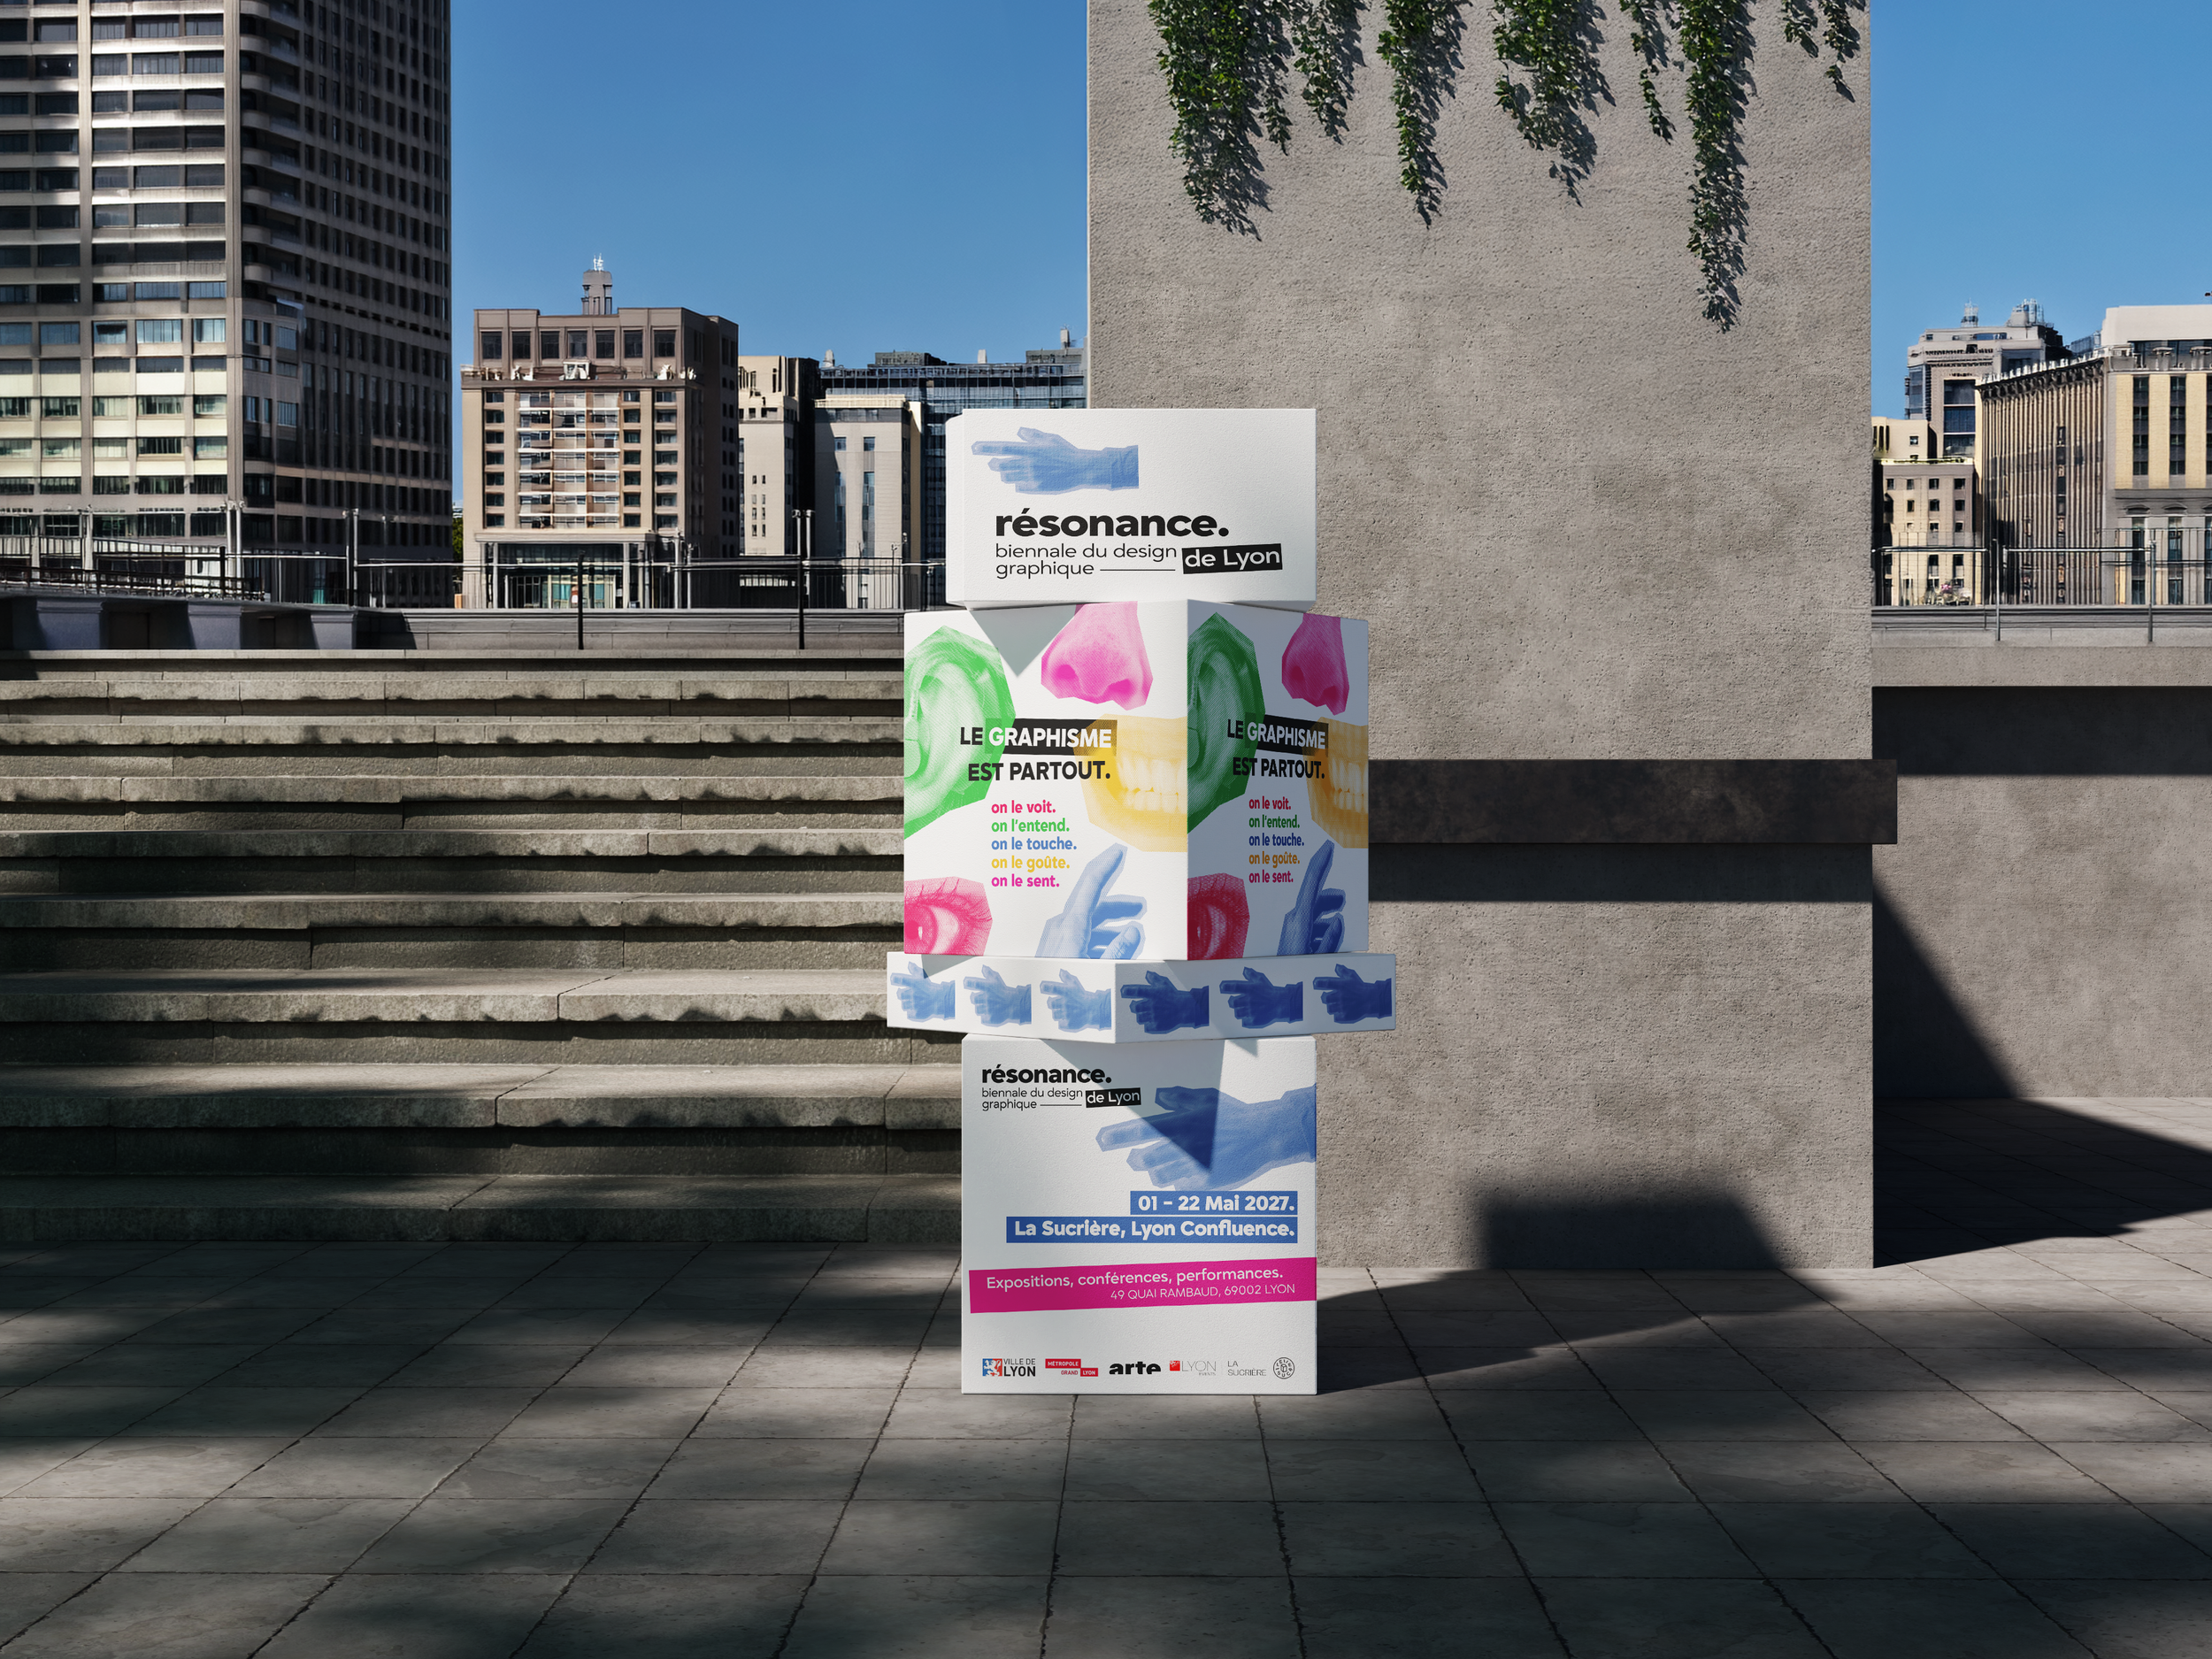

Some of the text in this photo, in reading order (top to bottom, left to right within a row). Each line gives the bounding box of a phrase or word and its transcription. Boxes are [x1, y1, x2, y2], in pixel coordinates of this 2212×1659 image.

[995, 508, 1229, 537] résonance.
[995, 543, 1279, 570] biennale du design de Lyon
[995, 560, 1094, 579] graphique
[961, 727, 1111, 748] LE GRAPHISME
[1227, 719, 1325, 749] LE GRAPHISME
[969, 761, 1110, 781] EST PARTOUT.
[1233, 757, 1325, 779] EST PARTOUT.
[992, 800, 1056, 813] on le voit.
[1249, 796, 1291, 810] on le voit.
[992, 822, 1007, 832] on
[1249, 818, 1260, 827] on
[992, 836, 1077, 849] on le touche.
[1249, 833, 1304, 846] on le touche.
[992, 856, 1070, 872] on le goûte.
[1249, 851, 1300, 868] on le goûte.
[992, 873, 1060, 887] on le sent.
[1249, 870, 1294, 883] on le sent.
[982, 1064, 1111, 1083] résonance.
[982, 1087, 1140, 1105] biennale du design de Lyon
[982, 1099, 1037, 1111] graphique
[1139, 1195, 1157, 1210] 01
[1179, 1196, 1201, 1210] 22
[1205, 1195, 1240, 1210] Mai
[1245, 1196, 1294, 1211] 2027.
[1015, 1220, 1294, 1240] La Sucrière, Lyon Confluence.
[987, 1267, 1283, 1292] Expositions, conférences, performances.
[1110, 1284, 1295, 1300] 49 QUAI RAMBAUD, 69002 LYON
[1003, 1366, 1035, 1377] LYON
[1110, 1361, 1161, 1374] arte
[1182, 1361, 1216, 1371] LYON
